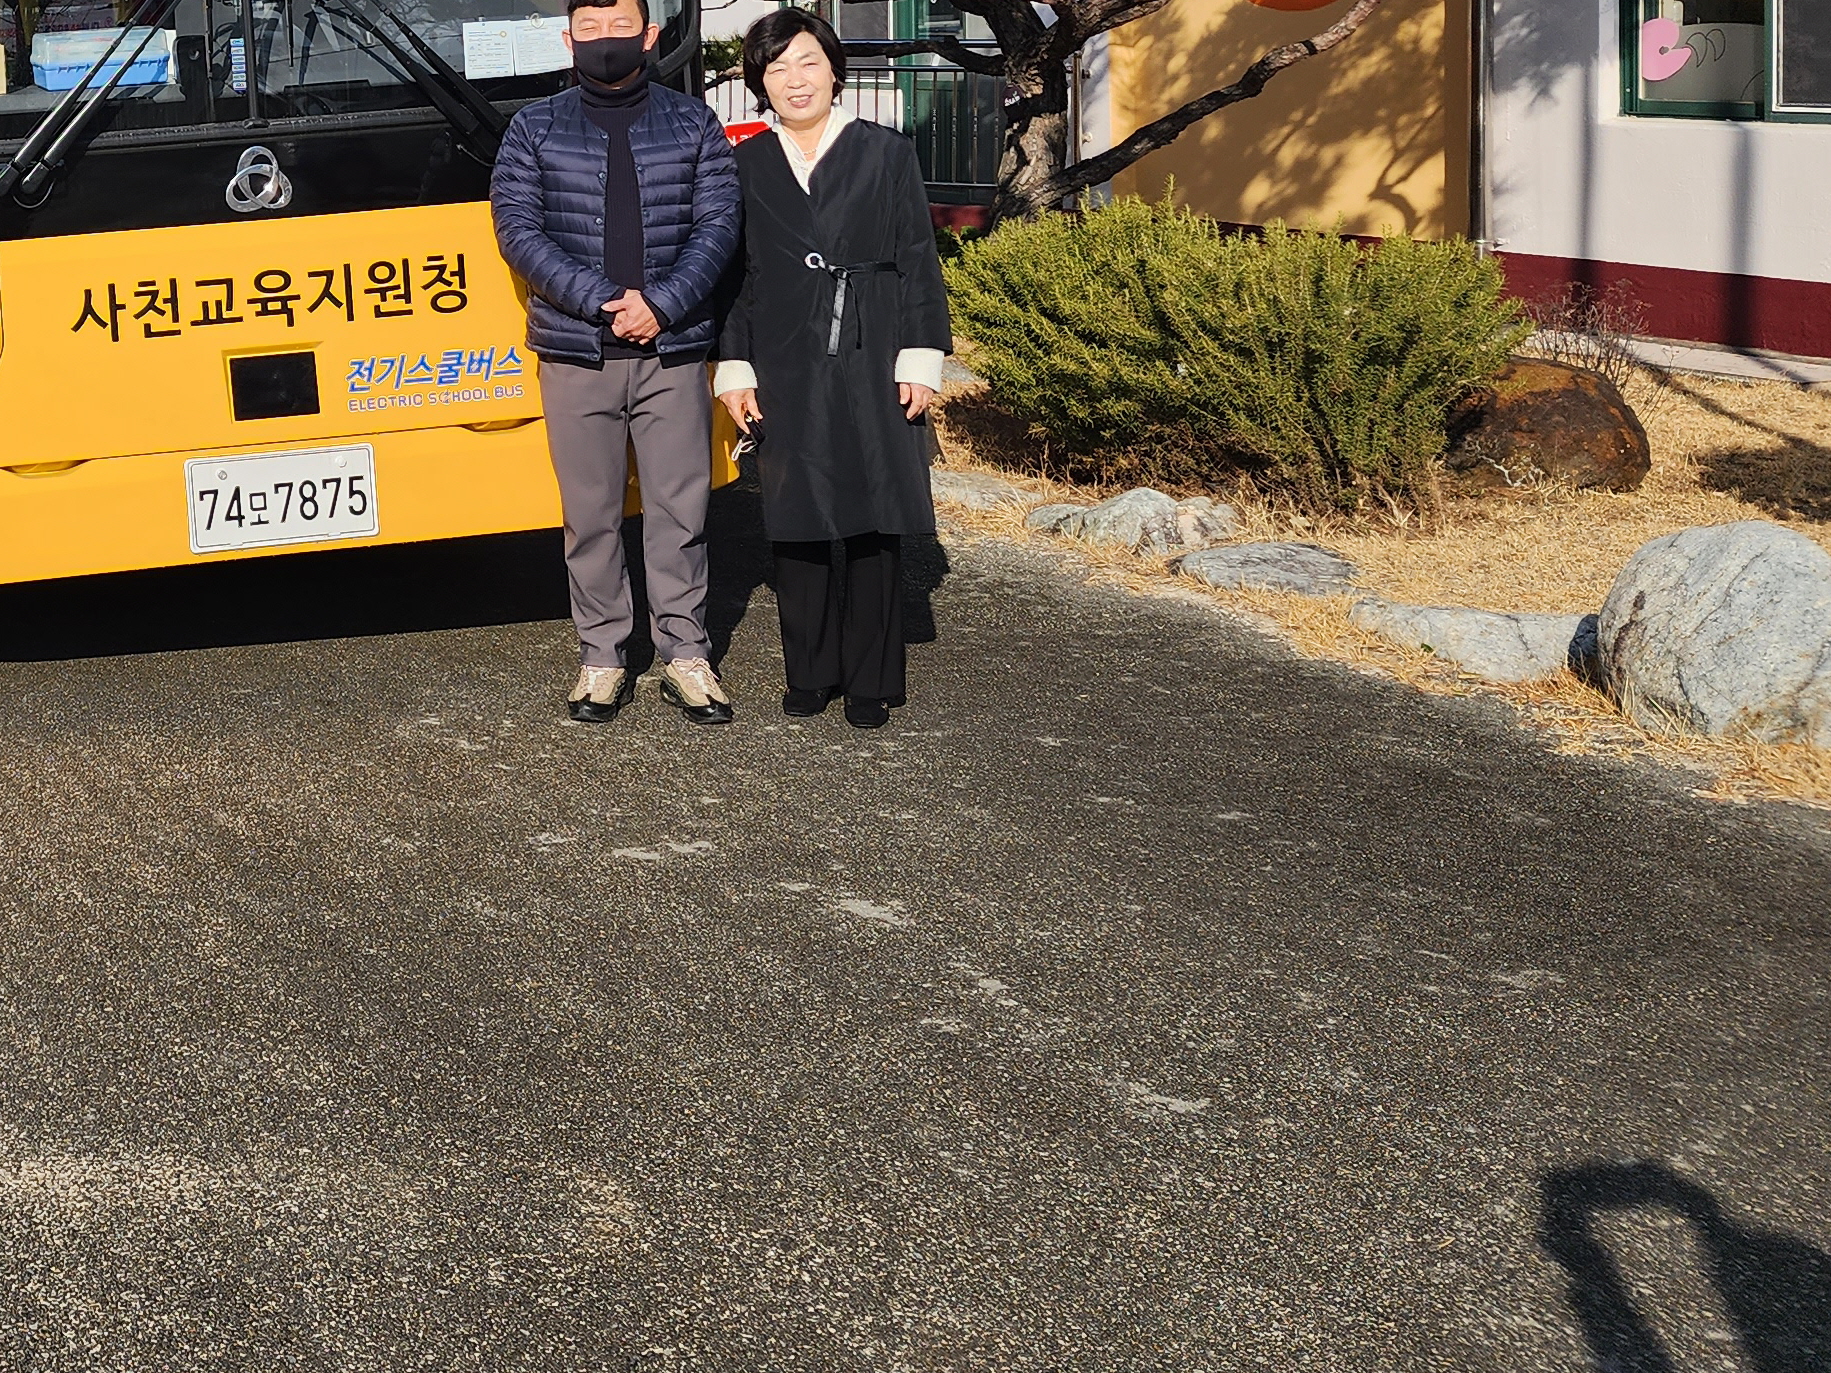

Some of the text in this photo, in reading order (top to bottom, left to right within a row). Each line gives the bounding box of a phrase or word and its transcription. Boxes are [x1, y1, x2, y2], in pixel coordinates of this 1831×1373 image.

[71, 252, 469, 343] 사천교육지원청
[345, 345, 524, 393] 전기스쿨버스
[348, 385, 524, 412] ELECTRIC SCHOOL BUS
[198, 474, 368, 532] 74모7875
